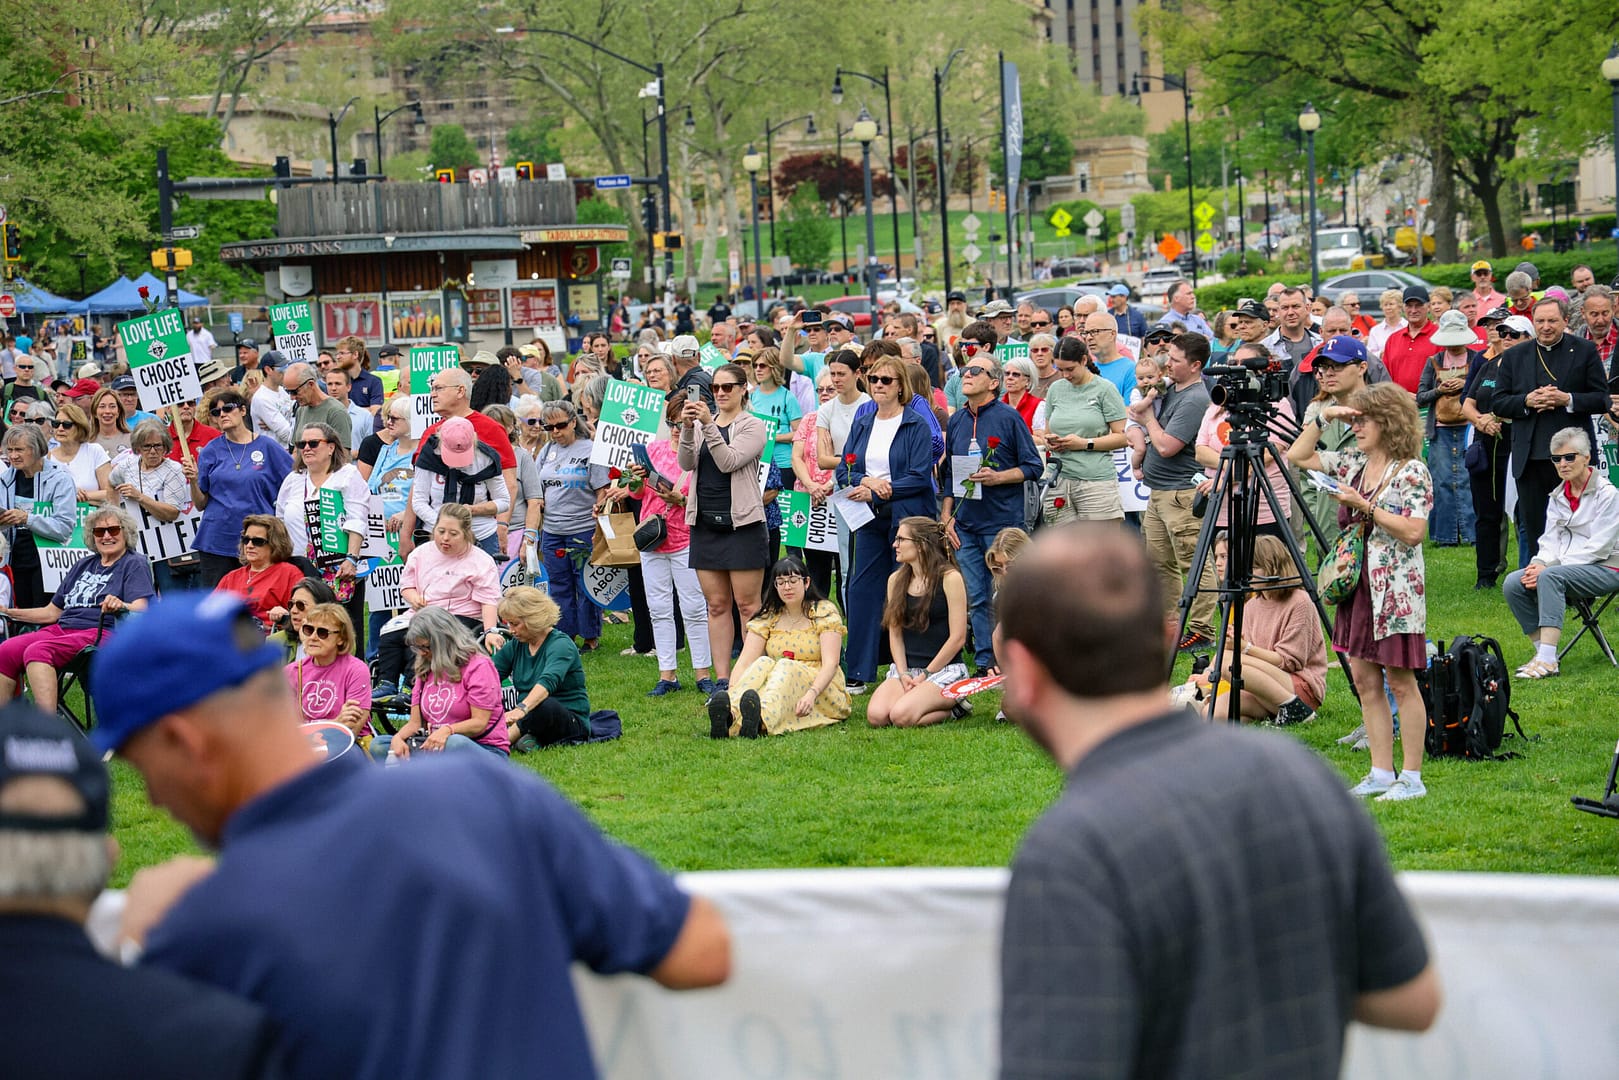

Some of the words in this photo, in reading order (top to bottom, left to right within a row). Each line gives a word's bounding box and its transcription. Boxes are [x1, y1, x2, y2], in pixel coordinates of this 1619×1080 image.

[271, 306, 291, 321] LOVE
[291, 304, 309, 319] LIFE
[122, 320, 155, 346] LOVE
[154, 312, 181, 337] LIFE
[279, 333, 312, 349] CHOOSE
[412, 351, 435, 372] LOVE
[437, 350, 457, 370] LIFE
[700, 345, 719, 364] LIFE
[993, 348, 1006, 362] VE
[139, 357, 190, 387] CHOOSE
[157, 381, 184, 406] LIFE
[607, 382, 637, 406] LOVE
[637, 389, 663, 413] LIFE
[416, 396, 434, 415] CHO
[608, 447, 633, 469] LIFE
[321, 490, 336, 517] LIFE
[776, 492, 792, 514] LIFE
[323, 518, 338, 549] LOVE
[367, 513, 385, 539] LIFE
[371, 566, 405, 588] CHOO
[589, 566, 605, 581] TO
[592, 567, 621, 597] ABOR
[382, 587, 406, 608] LIFE
